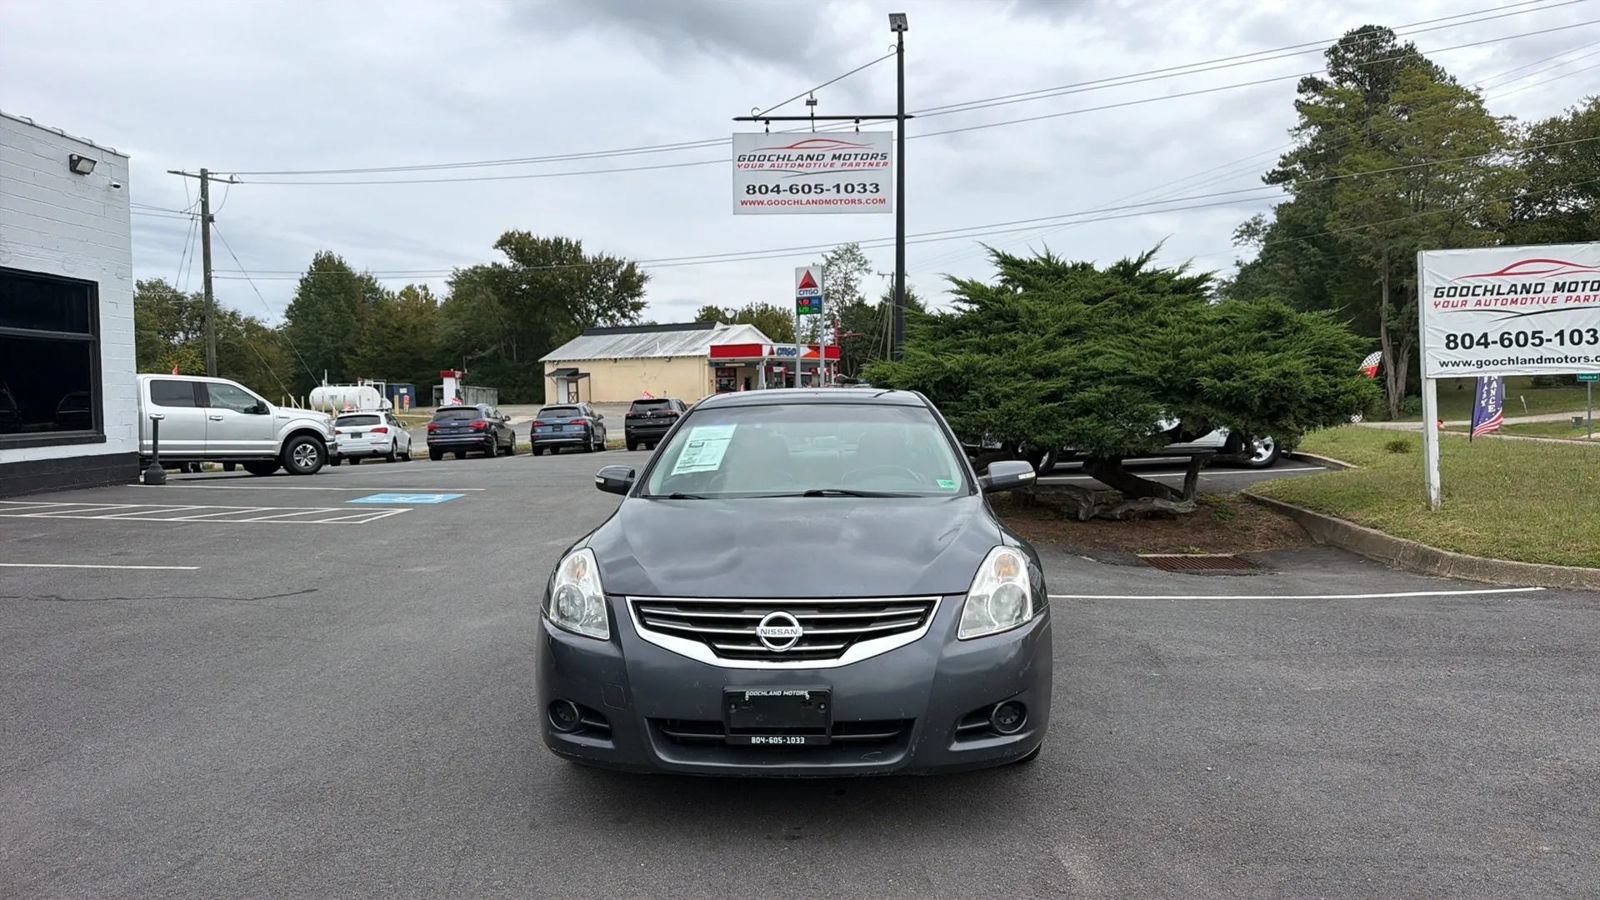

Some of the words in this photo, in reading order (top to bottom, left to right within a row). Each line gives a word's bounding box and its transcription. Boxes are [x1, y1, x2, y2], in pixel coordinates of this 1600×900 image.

[737, 154, 825, 162] GOOCHLAND
[831, 152, 889, 161] MOTORS
[769, 161, 836, 169] AUTOMOTIVE
[745, 183, 880, 195] 804-605-1033
[740, 198, 886, 206] WWW.GOOCHLANDMOTORS.COM
[1433, 282, 1546, 298] GOOCHLAND
[1433, 299, 1468, 309] YOUR
[1474, 296, 1558, 308] AUTOMOTIVE
[760, 628, 798, 636] NISSAN
[751, 736, 805, 744] 804-605-1033
